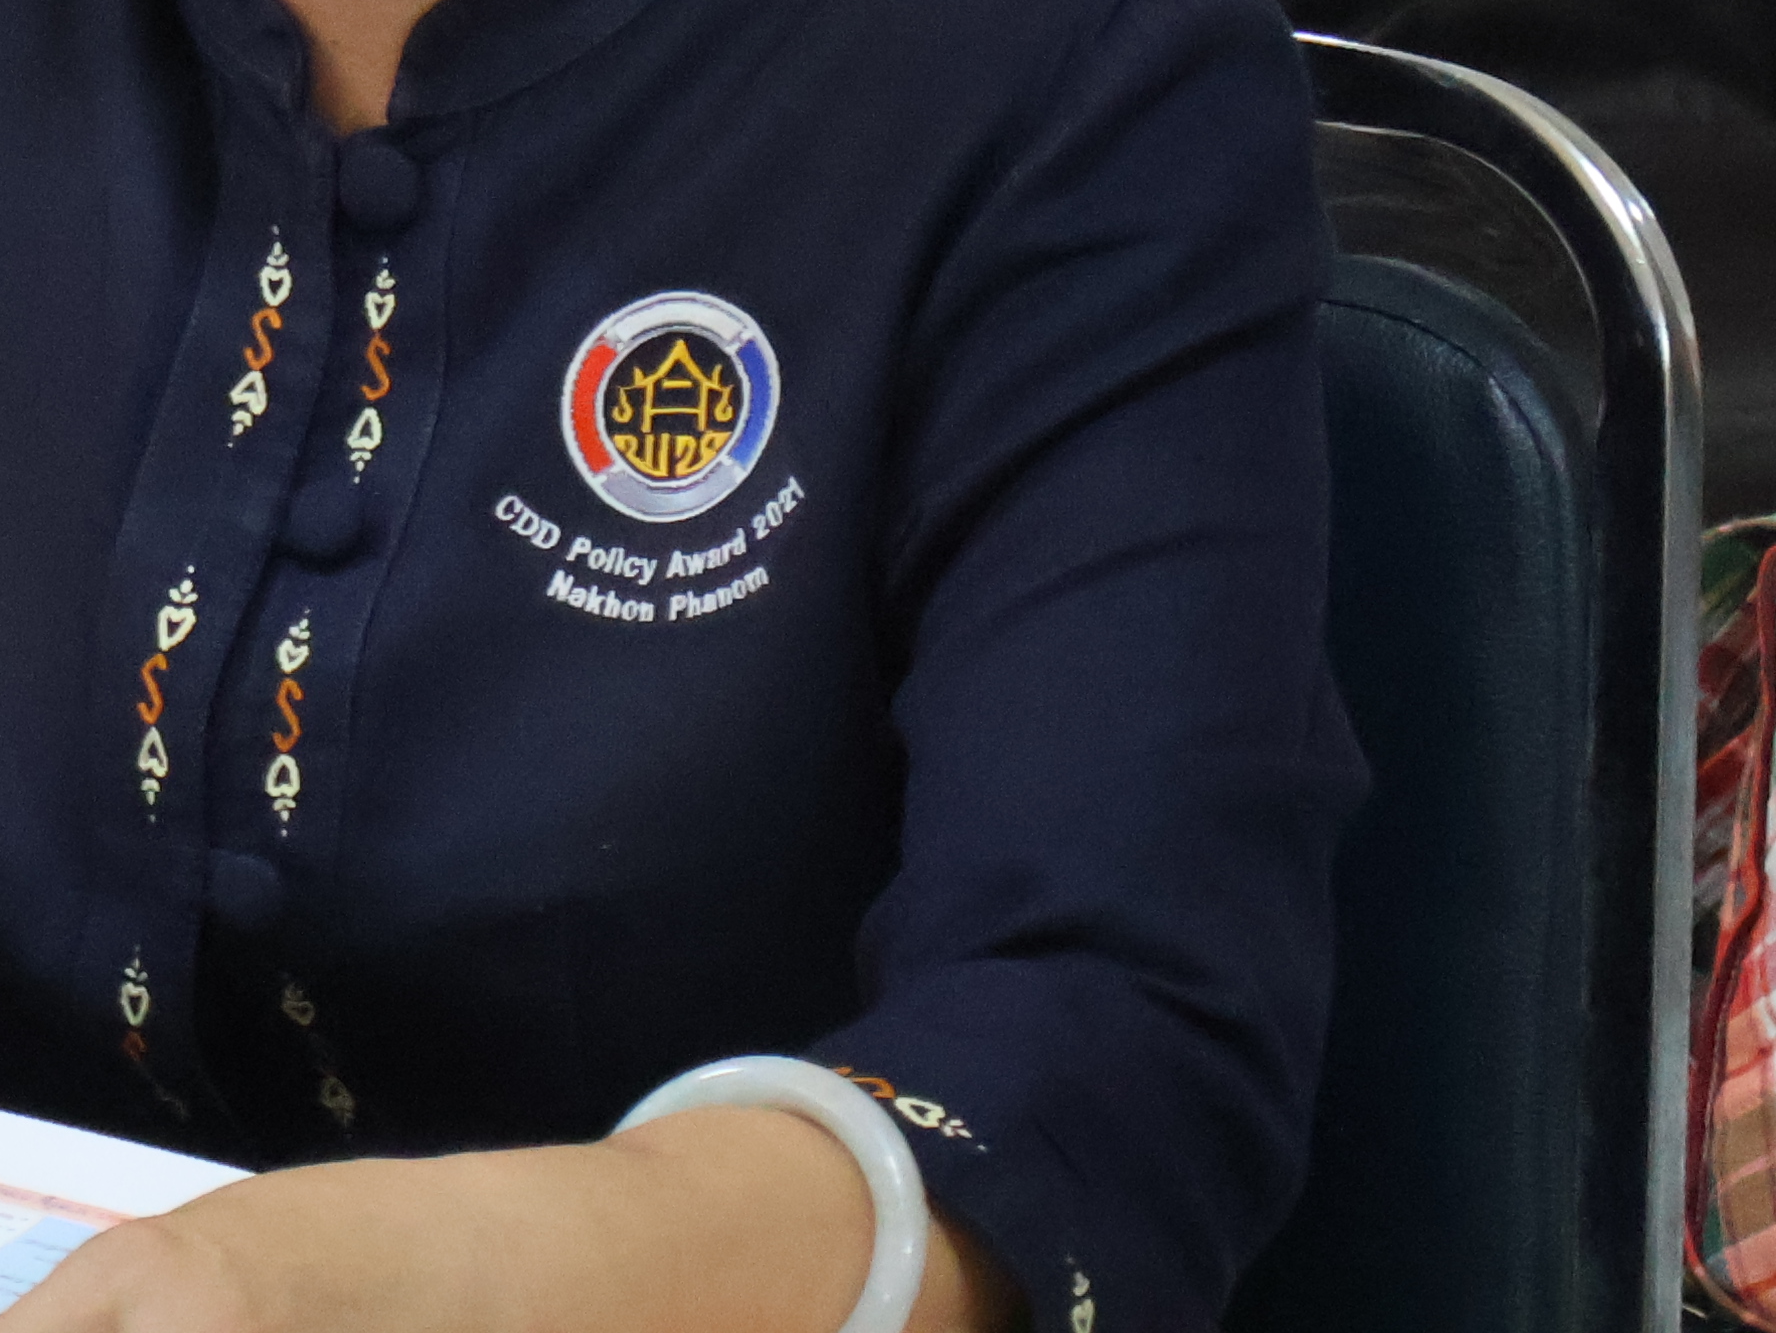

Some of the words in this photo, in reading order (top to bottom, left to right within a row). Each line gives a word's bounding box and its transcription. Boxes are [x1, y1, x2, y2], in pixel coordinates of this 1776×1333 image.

[495, 494, 562, 550] CDD
[566, 536, 658, 585] Policy
[665, 528, 748, 580] Award
[752, 476, 806, 540] 2021
[546, 569, 656, 622] Nakhon
[669, 566, 771, 621] Phanom
